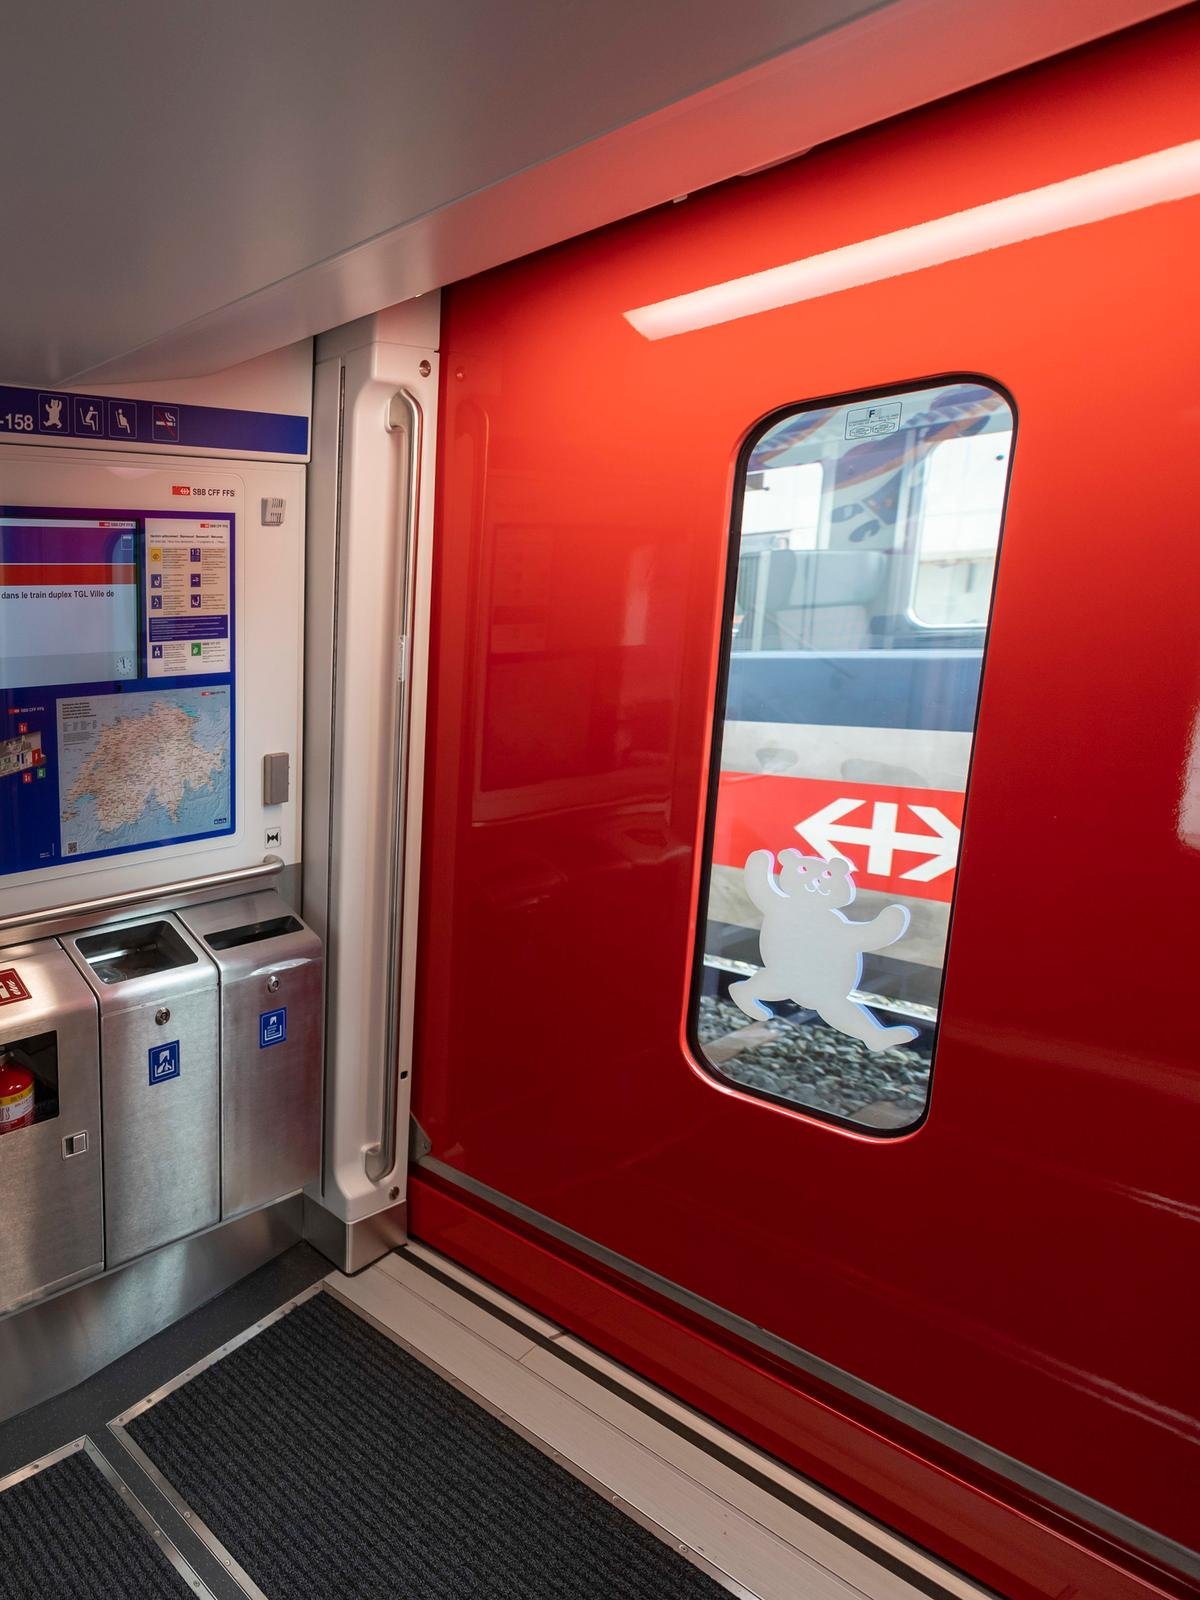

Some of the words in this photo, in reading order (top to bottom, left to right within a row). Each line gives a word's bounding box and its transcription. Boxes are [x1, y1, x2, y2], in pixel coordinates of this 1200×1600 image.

[869, 409, 876, 418] F
[192, 487, 207, 496] SBB
[208, 488, 221, 497] CFF
[222, 489, 235, 497] FFS
[1, 590, 20, 600] dans
[21, 590, 29, 599] le
[30, 590, 47, 599] train
[48, 590, 73, 601] duplex
[74, 590, 89, 599] TGL
[90, 589, 105, 598] Ville
[106, 589, 115, 598] de
